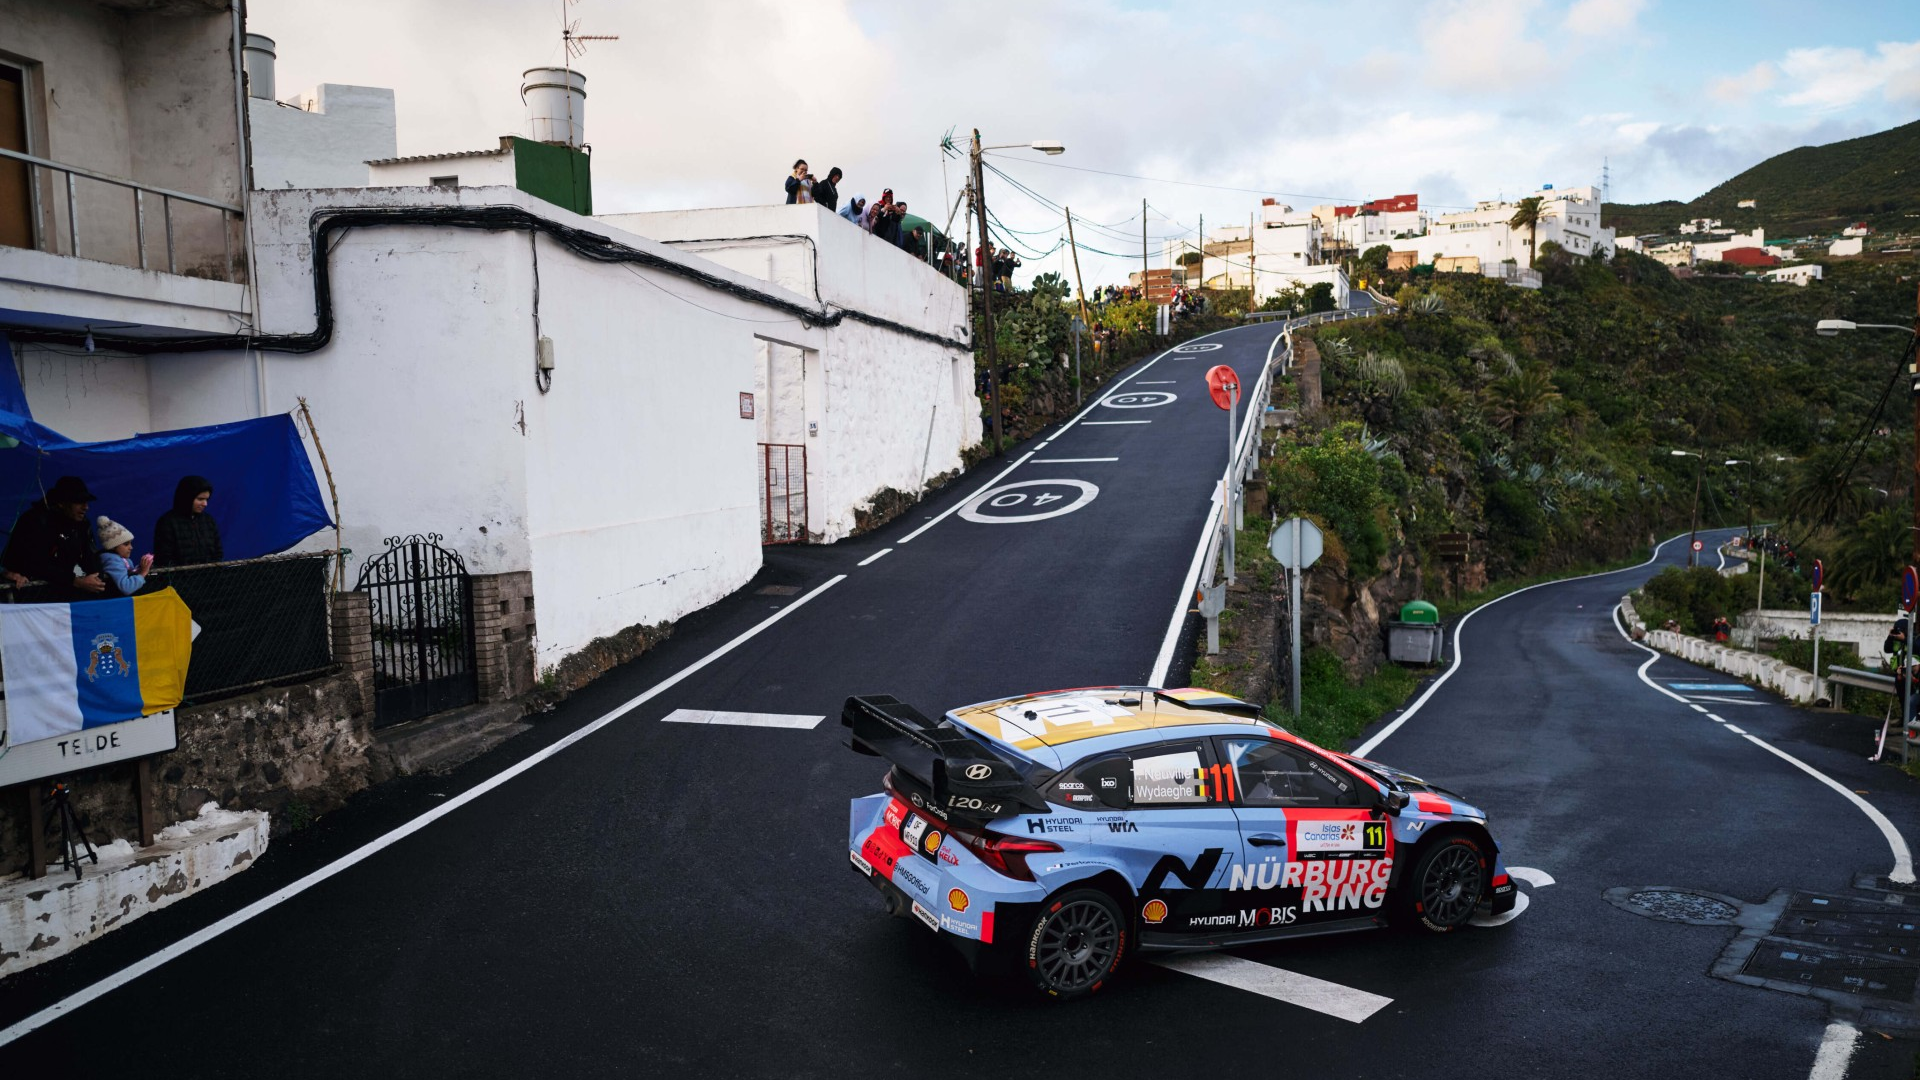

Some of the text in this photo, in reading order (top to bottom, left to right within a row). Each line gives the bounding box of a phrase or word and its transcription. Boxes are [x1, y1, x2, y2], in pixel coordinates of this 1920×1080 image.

[990, 493, 1063, 507] 40
[1811, 597, 1818, 620] P
[57, 731, 121, 758] TELDE
[1144, 767, 1192, 781] Neuville
[1317, 767, 1338, 784] HYUNDAI
[1209, 763, 1235, 802] 11
[1136, 784, 1193, 801] Wydaeghe
[948, 795, 982, 810] i20
[1045, 817, 1083, 825] HYUNDAI
[1108, 820, 1138, 833] WIA
[1322, 824, 1341, 833] Islas
[1304, 832, 1340, 841] Canarias
[1366, 826, 1383, 846] 11
[1229, 856, 1394, 891] NÜRBURG
[1302, 880, 1389, 913] RING
[950, 918, 978, 931] HYUNDAI
[1189, 906, 1296, 927] HYUNDAI MOBIS
[950, 925, 969, 935] STEEL
